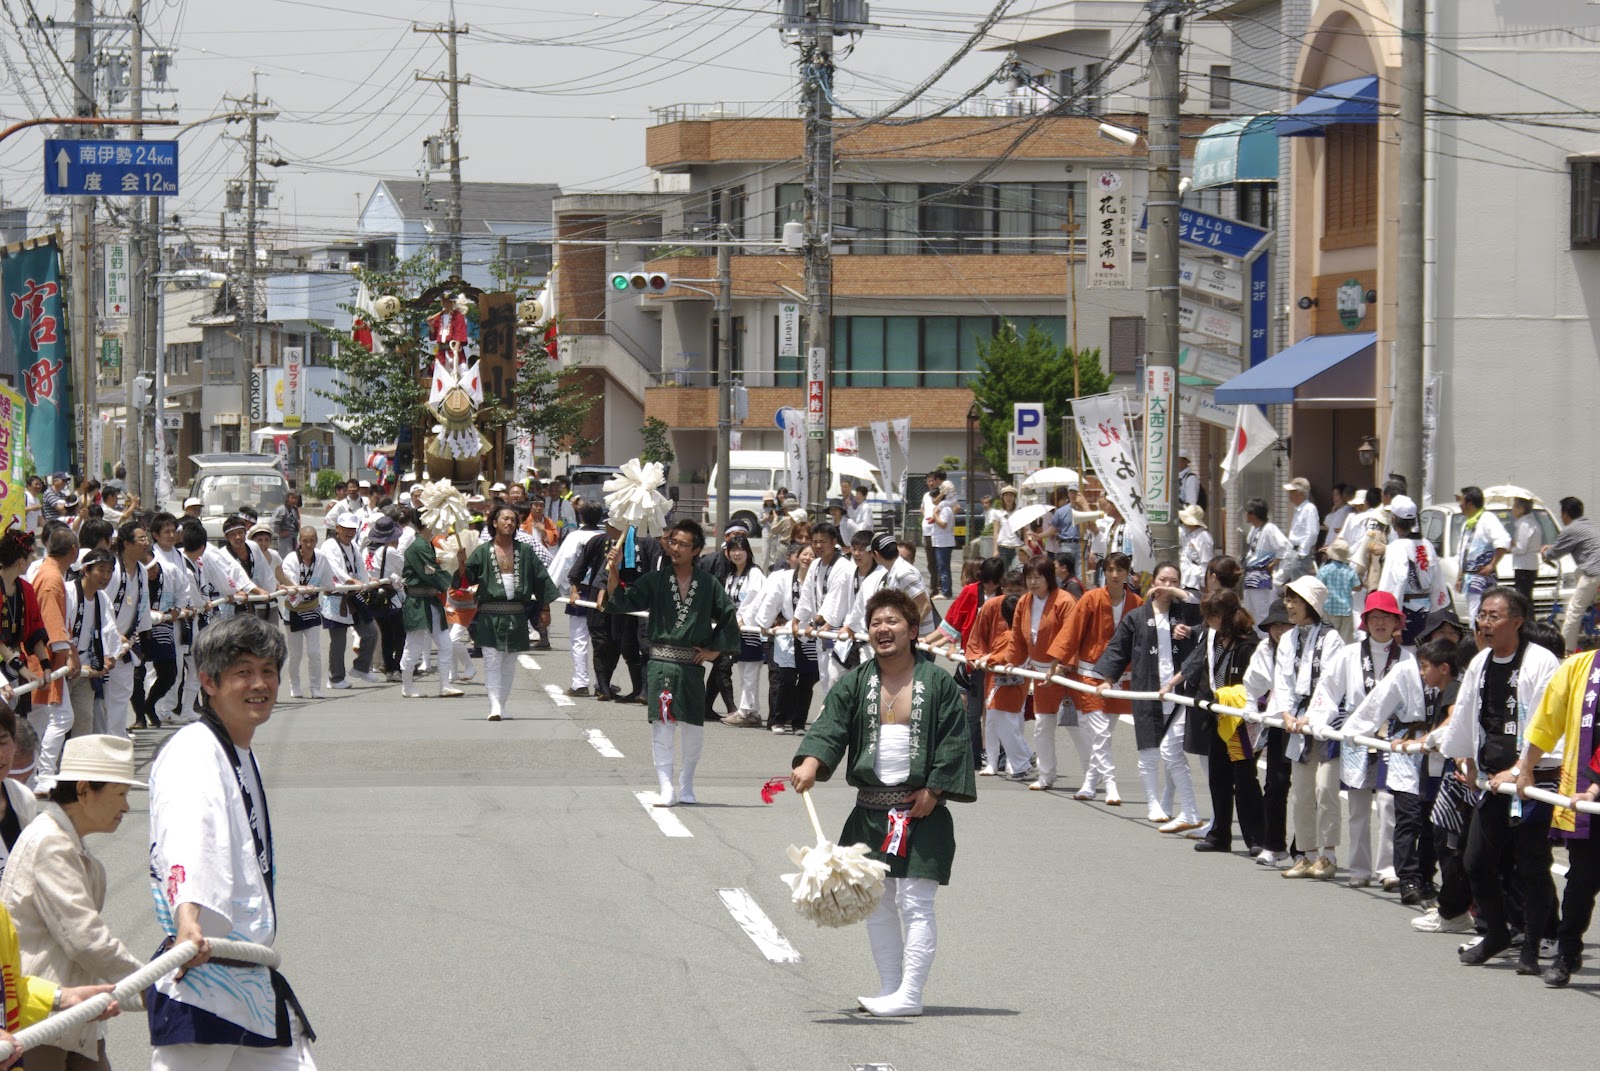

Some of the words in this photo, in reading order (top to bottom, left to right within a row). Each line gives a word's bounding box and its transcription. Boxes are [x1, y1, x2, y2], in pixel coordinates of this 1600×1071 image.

[79, 146, 132, 165] 南伊勢
[136, 147, 173, 165] 24Km
[144, 173, 176, 192] 12Km
[111, 246, 122, 269] 海野
[1253, 282, 1266, 290] 3F
[1253, 293, 1266, 301] 2F
[1253, 330, 1265, 338] 2F
[289, 363, 300, 388] ゼブラ
[251, 372, 260, 420] KOKUYO
[811, 383, 821, 411] 美鈴
[1018, 409, 1040, 435] P
[1017, 448, 1040, 456] 杉ビル
[1148, 396, 1166, 500] 大西クリニック
